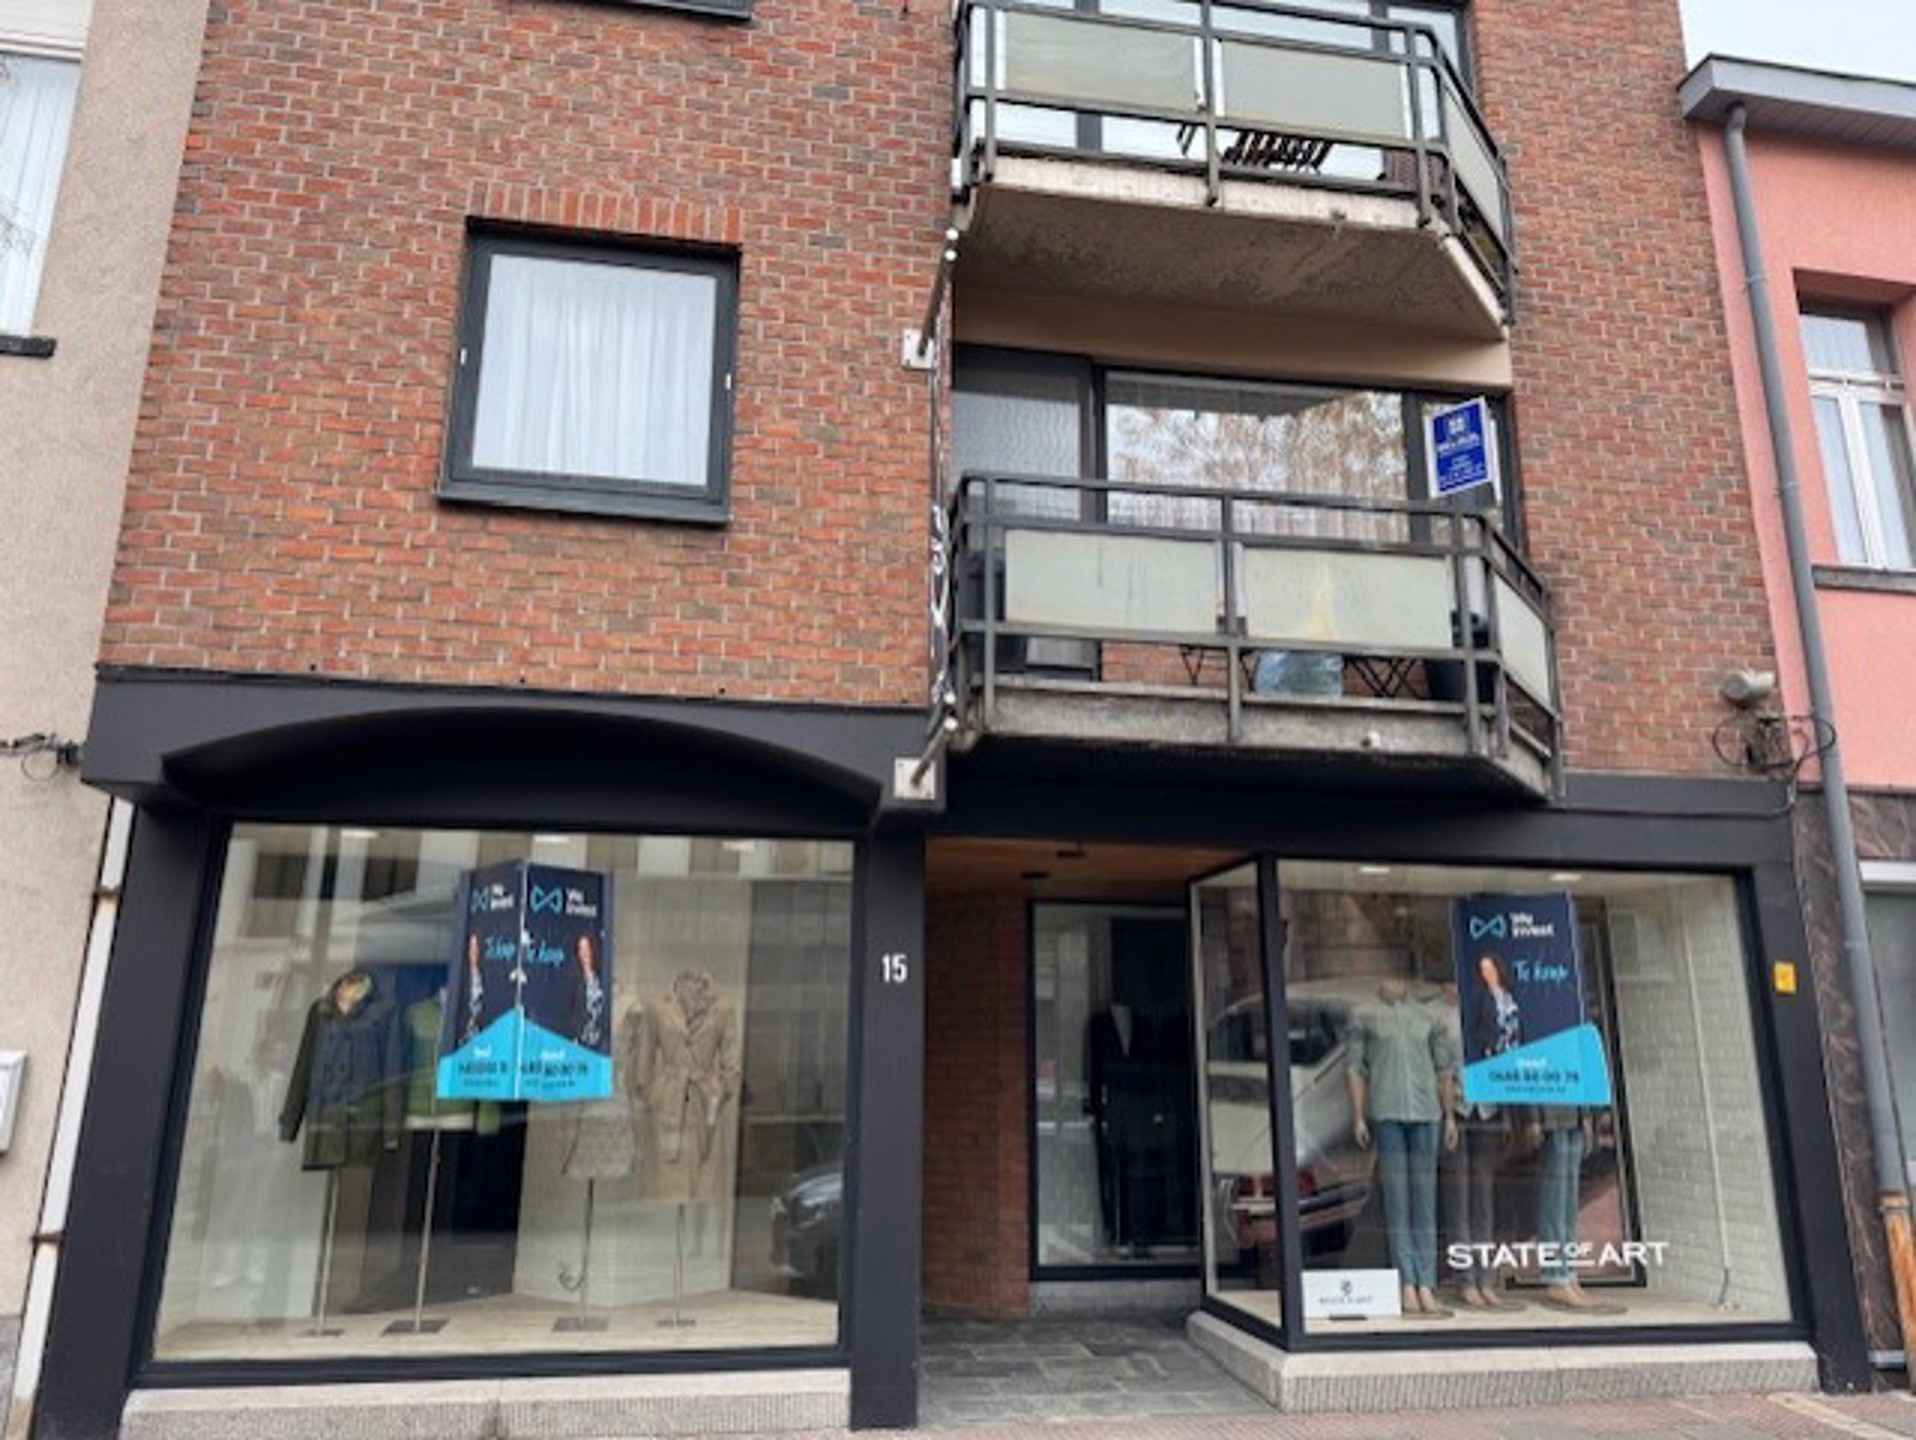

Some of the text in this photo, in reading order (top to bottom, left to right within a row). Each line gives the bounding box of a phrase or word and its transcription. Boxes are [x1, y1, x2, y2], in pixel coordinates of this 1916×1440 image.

[882, 953, 908, 983] 15
[1446, 1241, 1669, 1269] STATE OF ART
